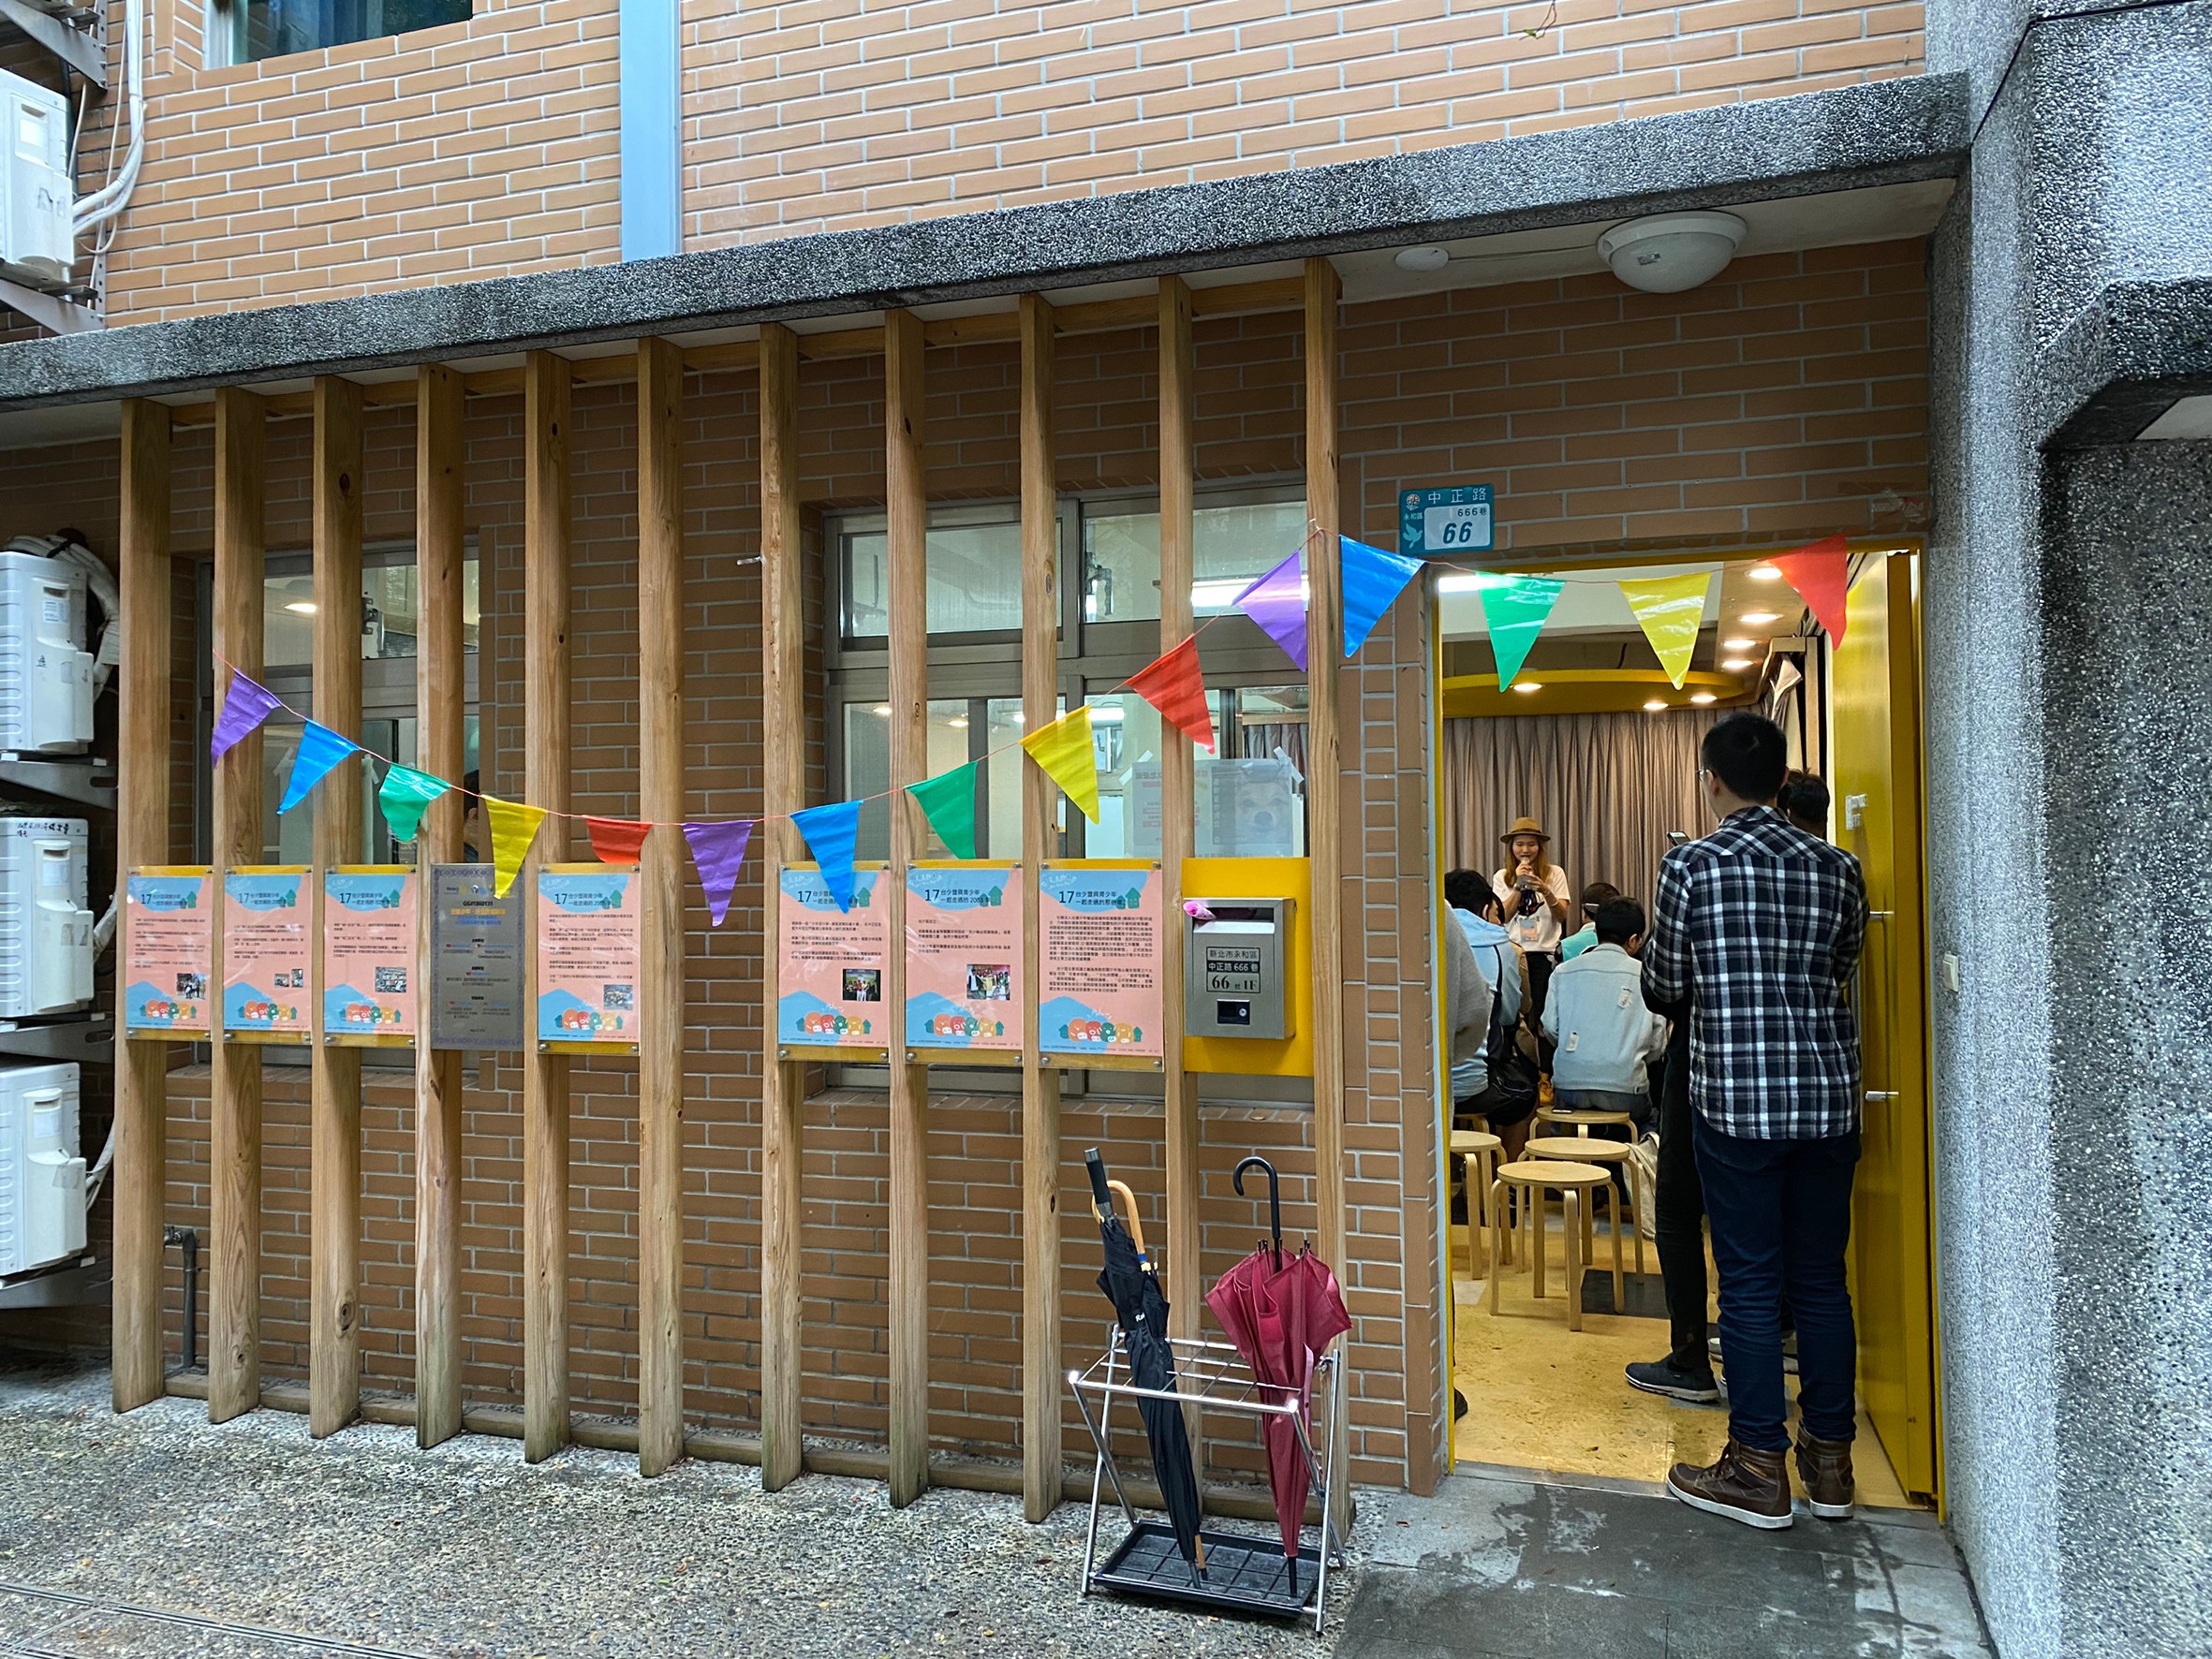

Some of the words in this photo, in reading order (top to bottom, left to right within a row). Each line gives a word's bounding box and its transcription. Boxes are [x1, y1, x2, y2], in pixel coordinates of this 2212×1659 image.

[1428, 488, 1486, 505] 中正路
[1442, 521, 1473, 544] 66
[140, 893, 153, 904] 17
[238, 892, 249, 903] 17
[339, 892, 352, 903] 17
[554, 893, 568, 904] 17
[797, 890, 812, 903] 17
[924, 888, 940, 902] 17
[1058, 890, 1074, 903] 17
[1210, 949, 1258, 959] 新北市永和區
[1212, 975, 1230, 990] 66
